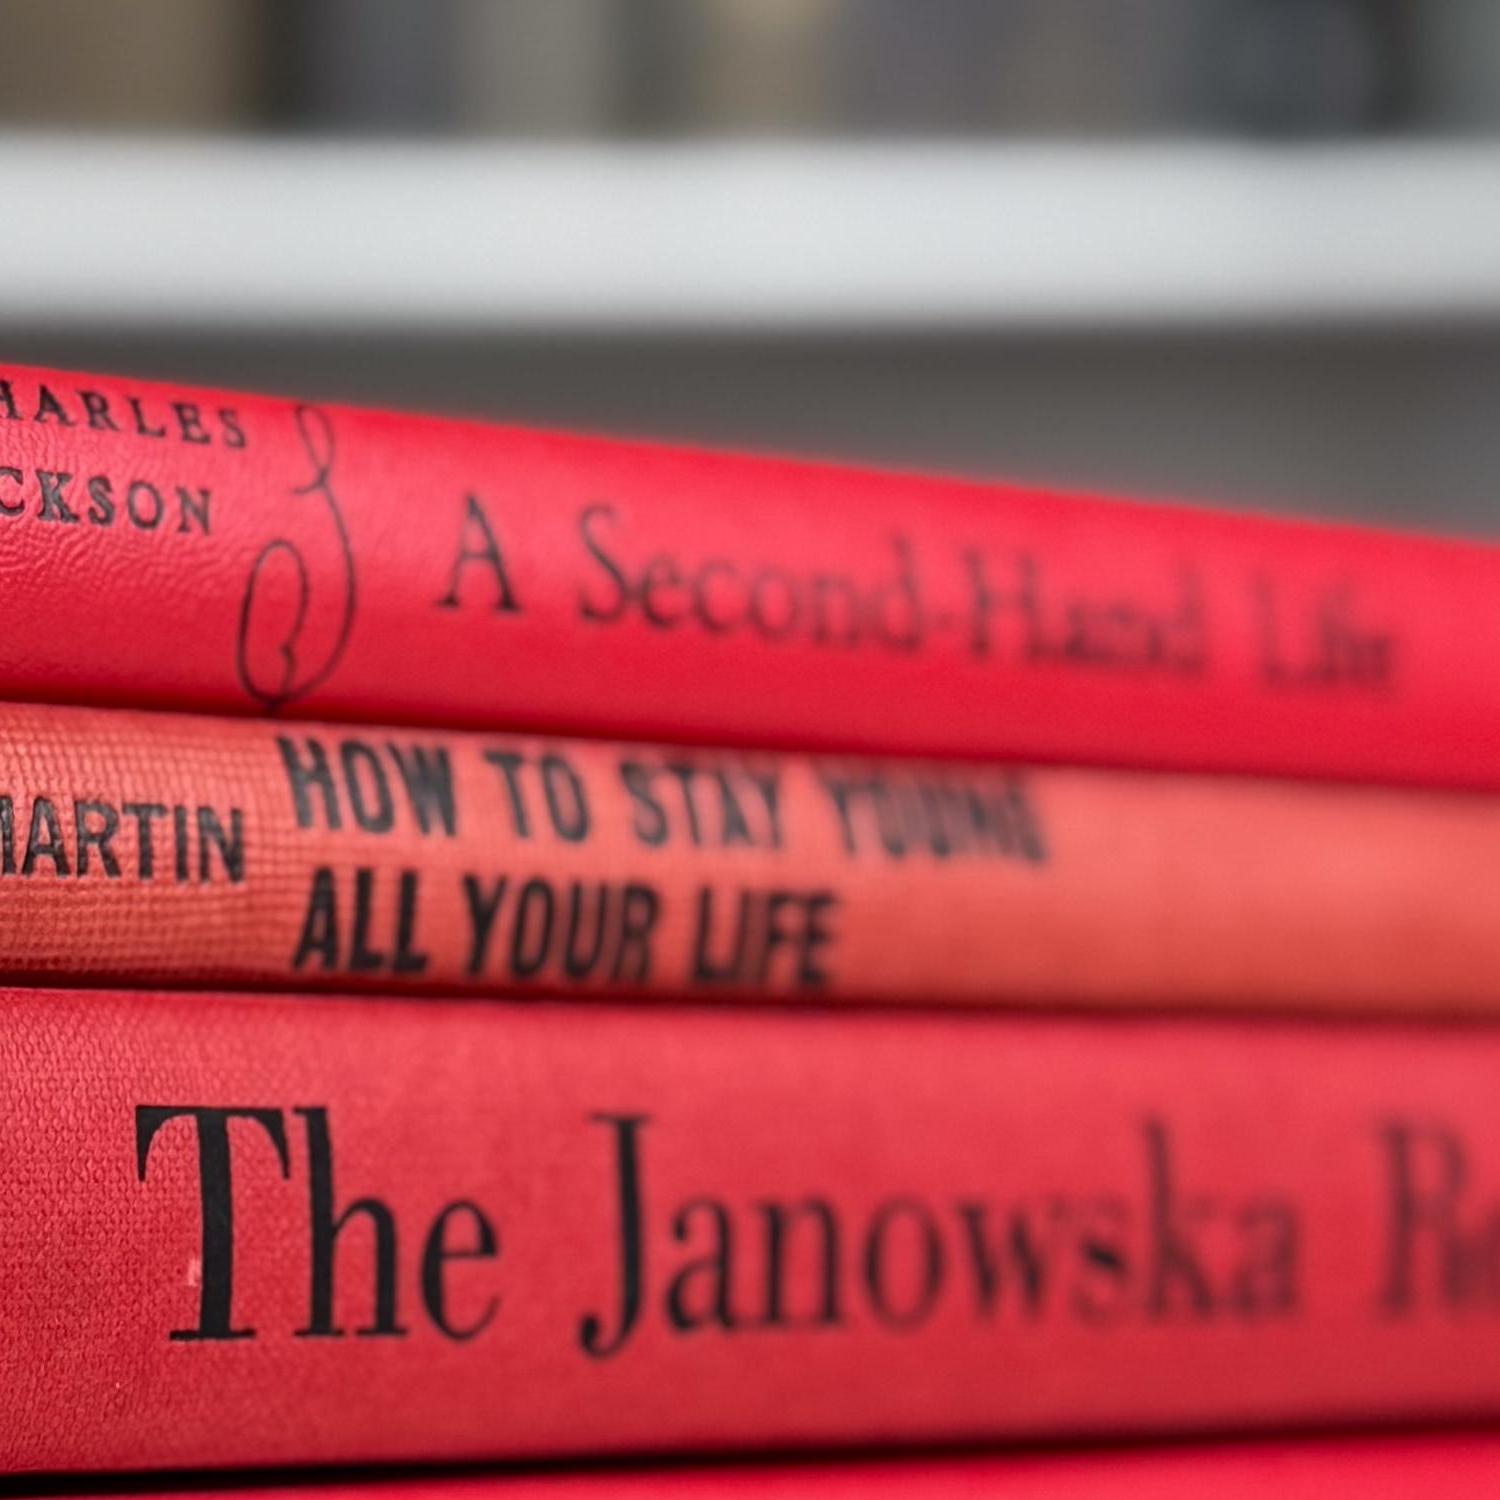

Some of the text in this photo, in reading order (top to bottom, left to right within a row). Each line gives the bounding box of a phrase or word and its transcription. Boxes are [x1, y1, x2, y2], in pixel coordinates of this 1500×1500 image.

[435, 490, 524, 616] A
[278, 735, 457, 837] HOW
[484, 748, 591, 843] TO
[619, 757, 782, 850] STAY
[294, 866, 840, 988] ALL YOUR LIFE
[134, 1104, 500, 1342] The
[578, 1112, 1300, 1360] Janowska
